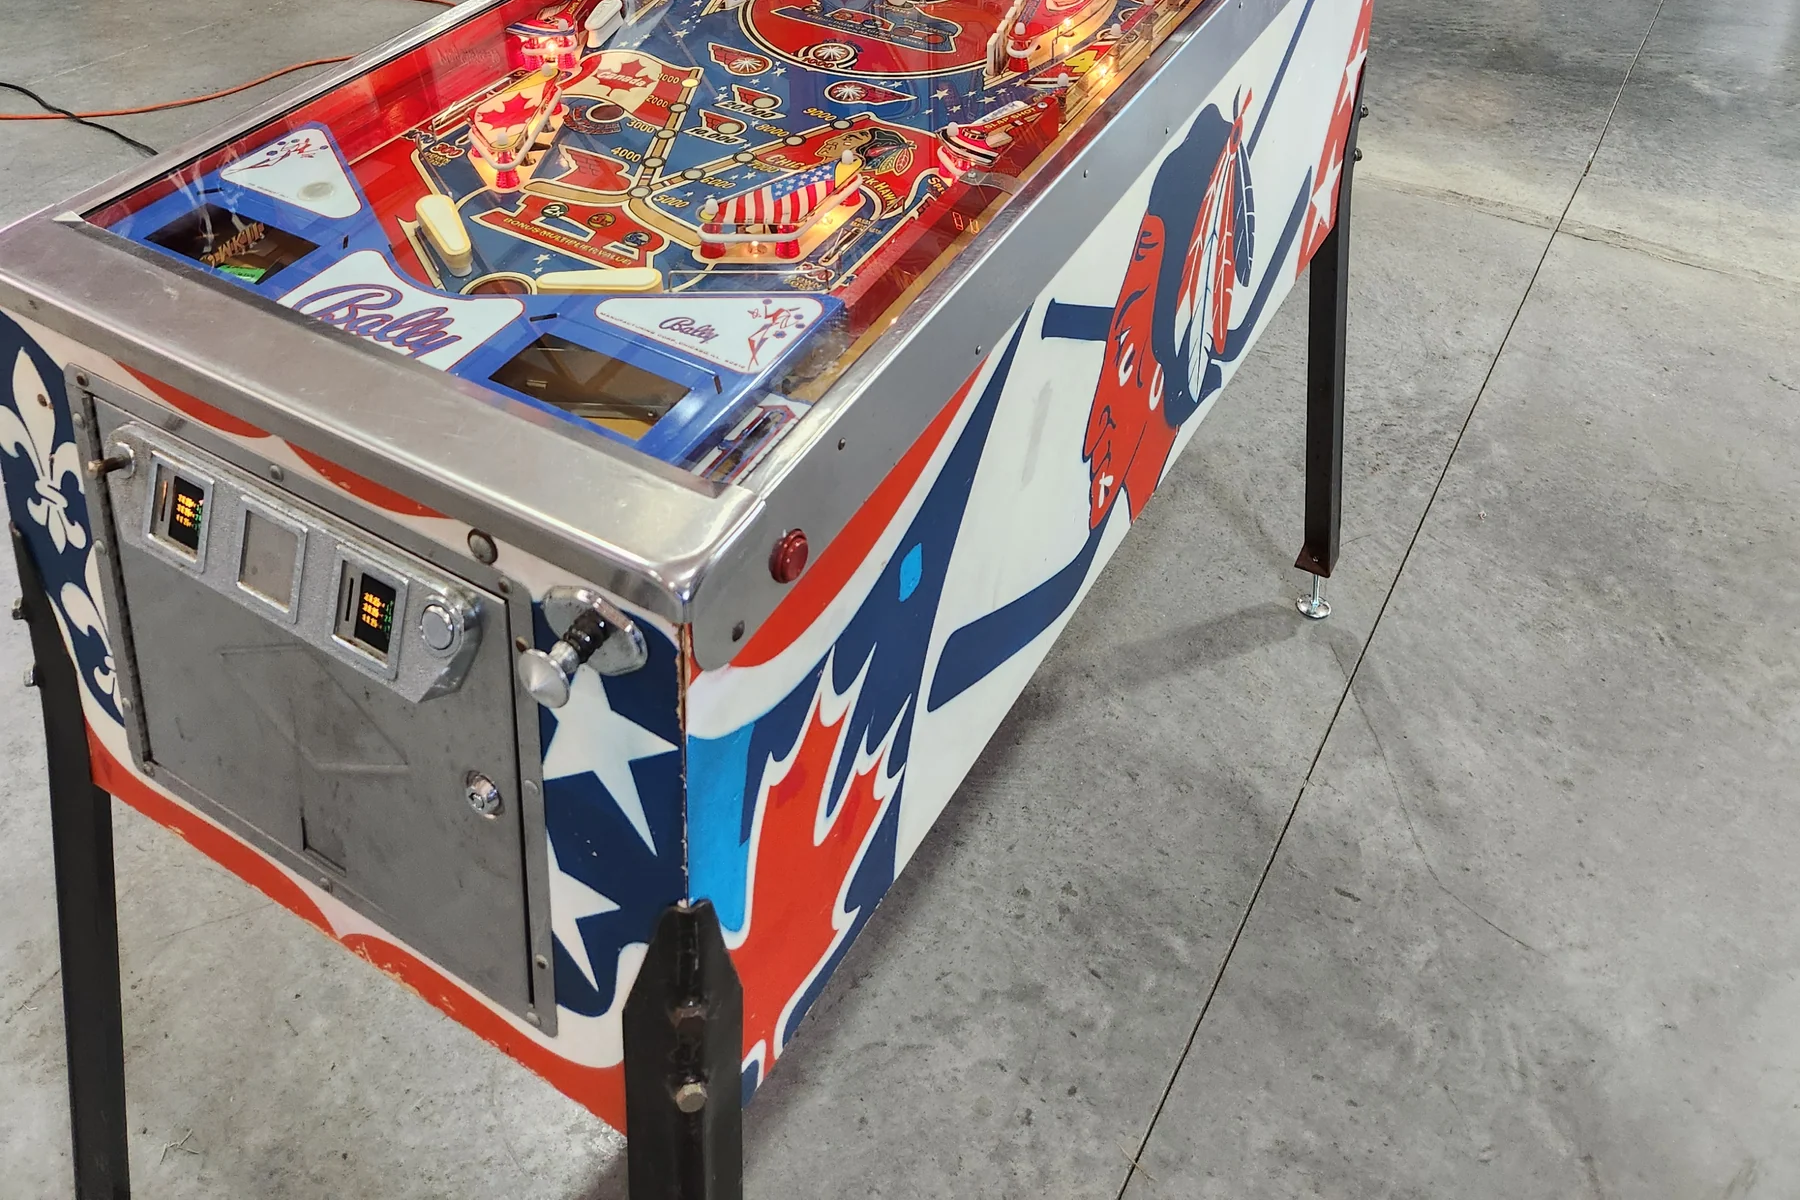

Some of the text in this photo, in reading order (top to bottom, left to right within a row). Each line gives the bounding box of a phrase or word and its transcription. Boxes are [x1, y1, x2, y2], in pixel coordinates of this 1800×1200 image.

[597, 70, 648, 87] Canada
[658, 73, 680, 84] 1000
[645, 94, 669, 108] 2000
[802, 107, 838, 122] 9000
[984, 117, 1009, 130] SLAP
[1010, 107, 1037, 119] SHOT
[626, 117, 656, 134] 3000
[755, 123, 790, 137] 8000
[611, 146, 642, 163] 4000
[701, 176, 737, 190] 6000
[656, 194, 690, 209] 5000
[503, 216, 540, 234] BONUS
[540, 229, 598, 254] MULTIPLIER
[292, 283, 462, 360] Bally
[659, 316, 719, 344] Bally
